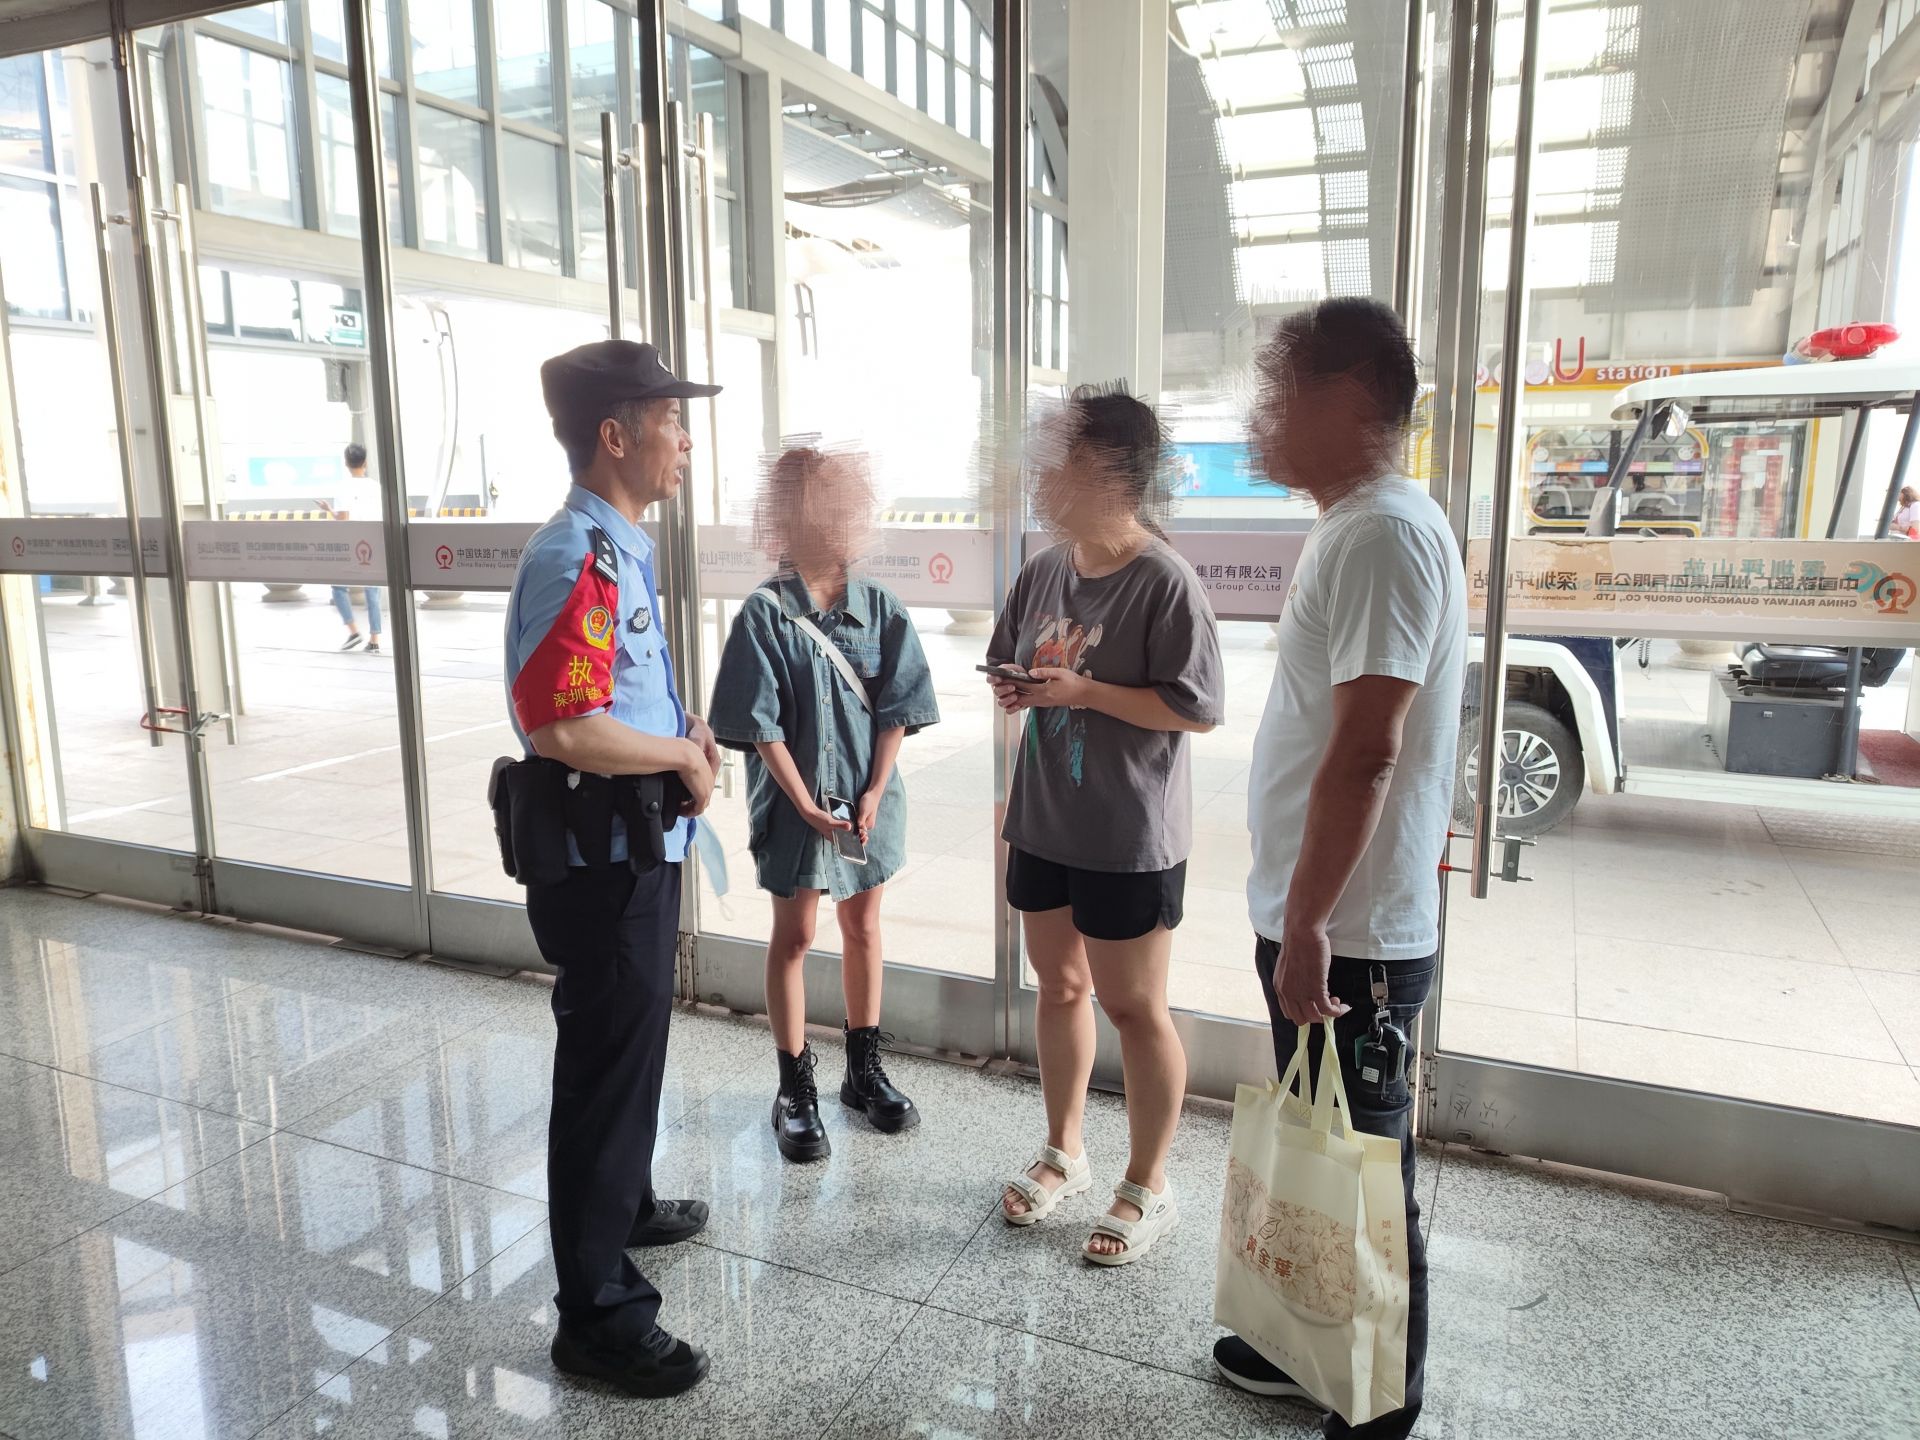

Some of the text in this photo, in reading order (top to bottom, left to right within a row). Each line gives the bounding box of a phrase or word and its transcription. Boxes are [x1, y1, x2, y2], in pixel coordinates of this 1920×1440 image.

[1554, 336, 1672, 383] U station
[1195, 563, 1282, 580] 集团有限公司
[1215, 582, 1244, 592] Group
[553, 685, 605, 708] 深圳铁
